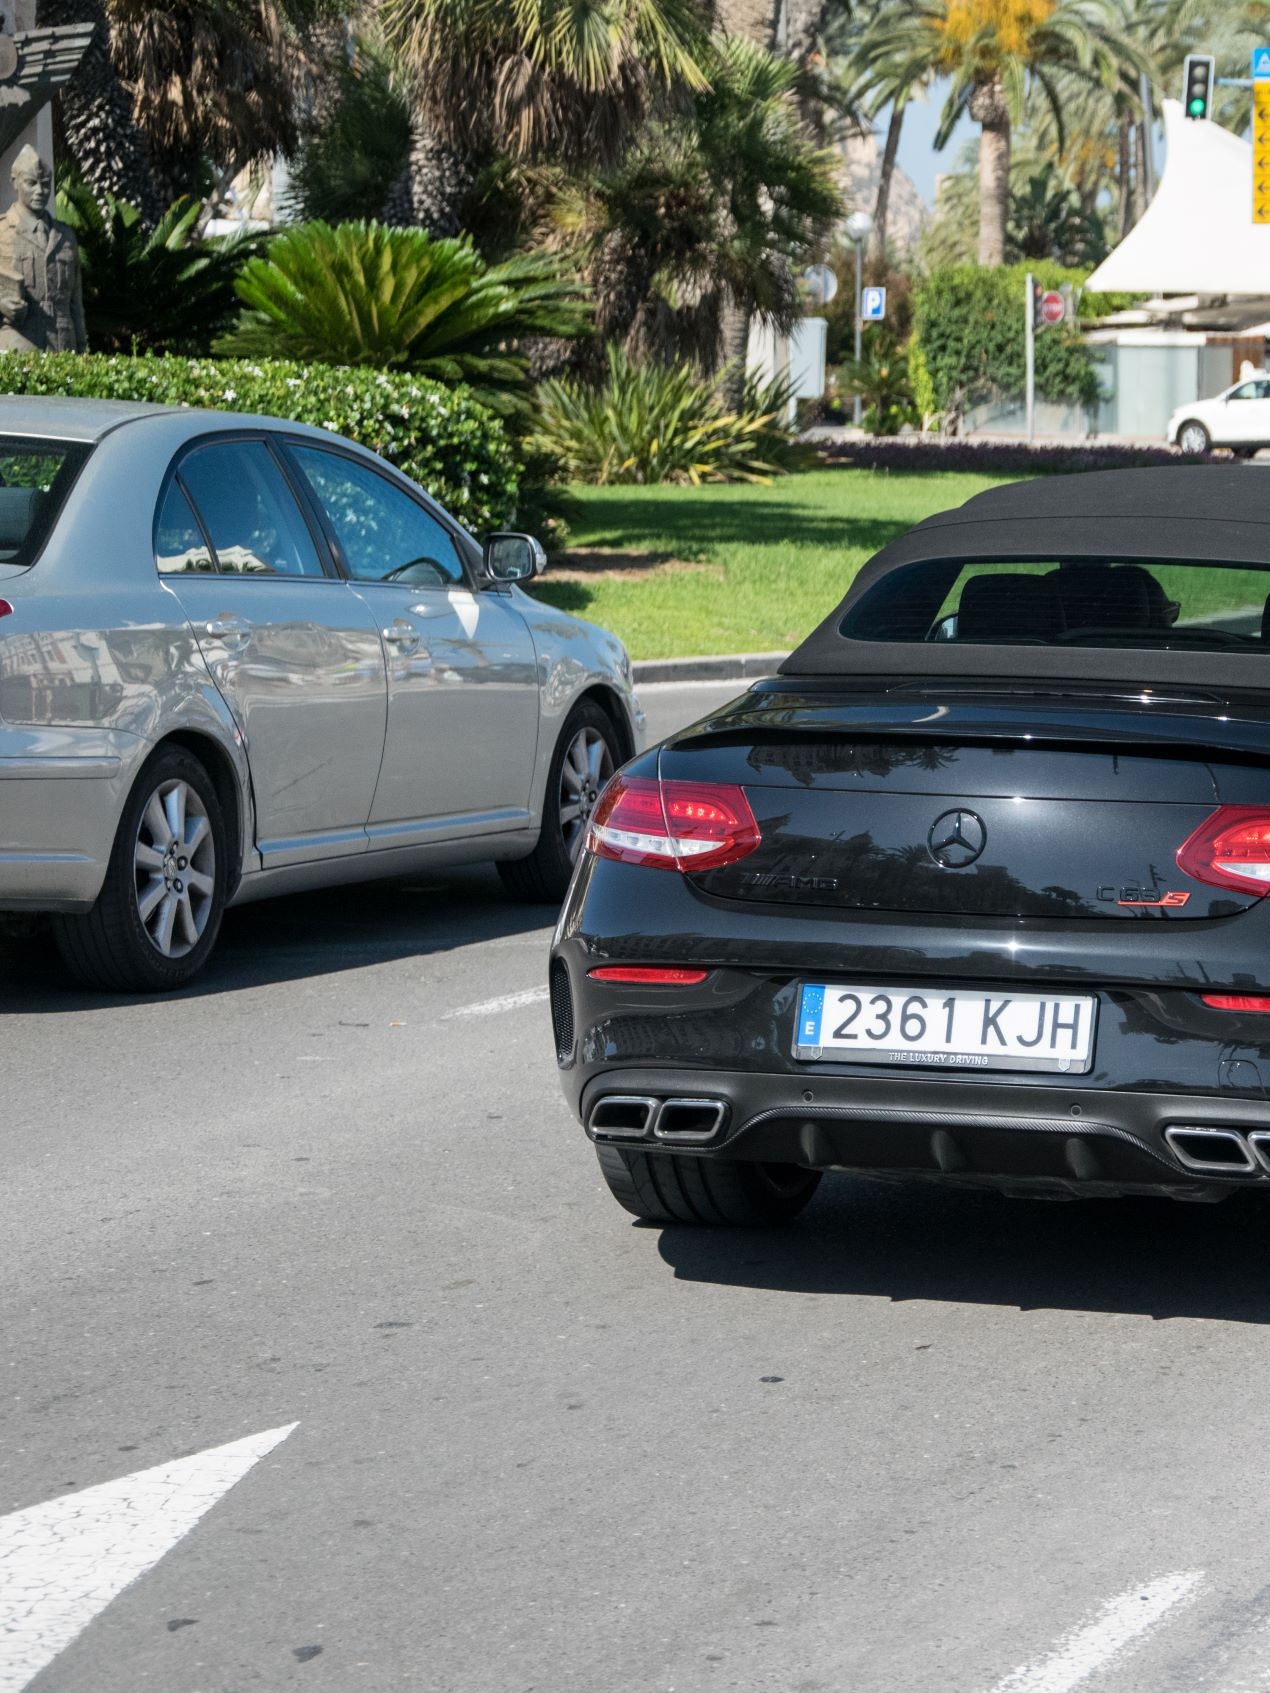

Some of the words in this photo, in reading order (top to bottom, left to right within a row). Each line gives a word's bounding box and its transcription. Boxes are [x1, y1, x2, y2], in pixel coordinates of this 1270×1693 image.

[866, 290, 882, 314] P
[804, 1021, 815, 1035] E
[832, 993, 956, 1044] 2361
[980, 998, 1081, 1050] KJH
[888, 1052, 907, 1061] THE
[909, 1053, 947, 1063] LUXURY
[949, 1055, 989, 1065] DRIVING
